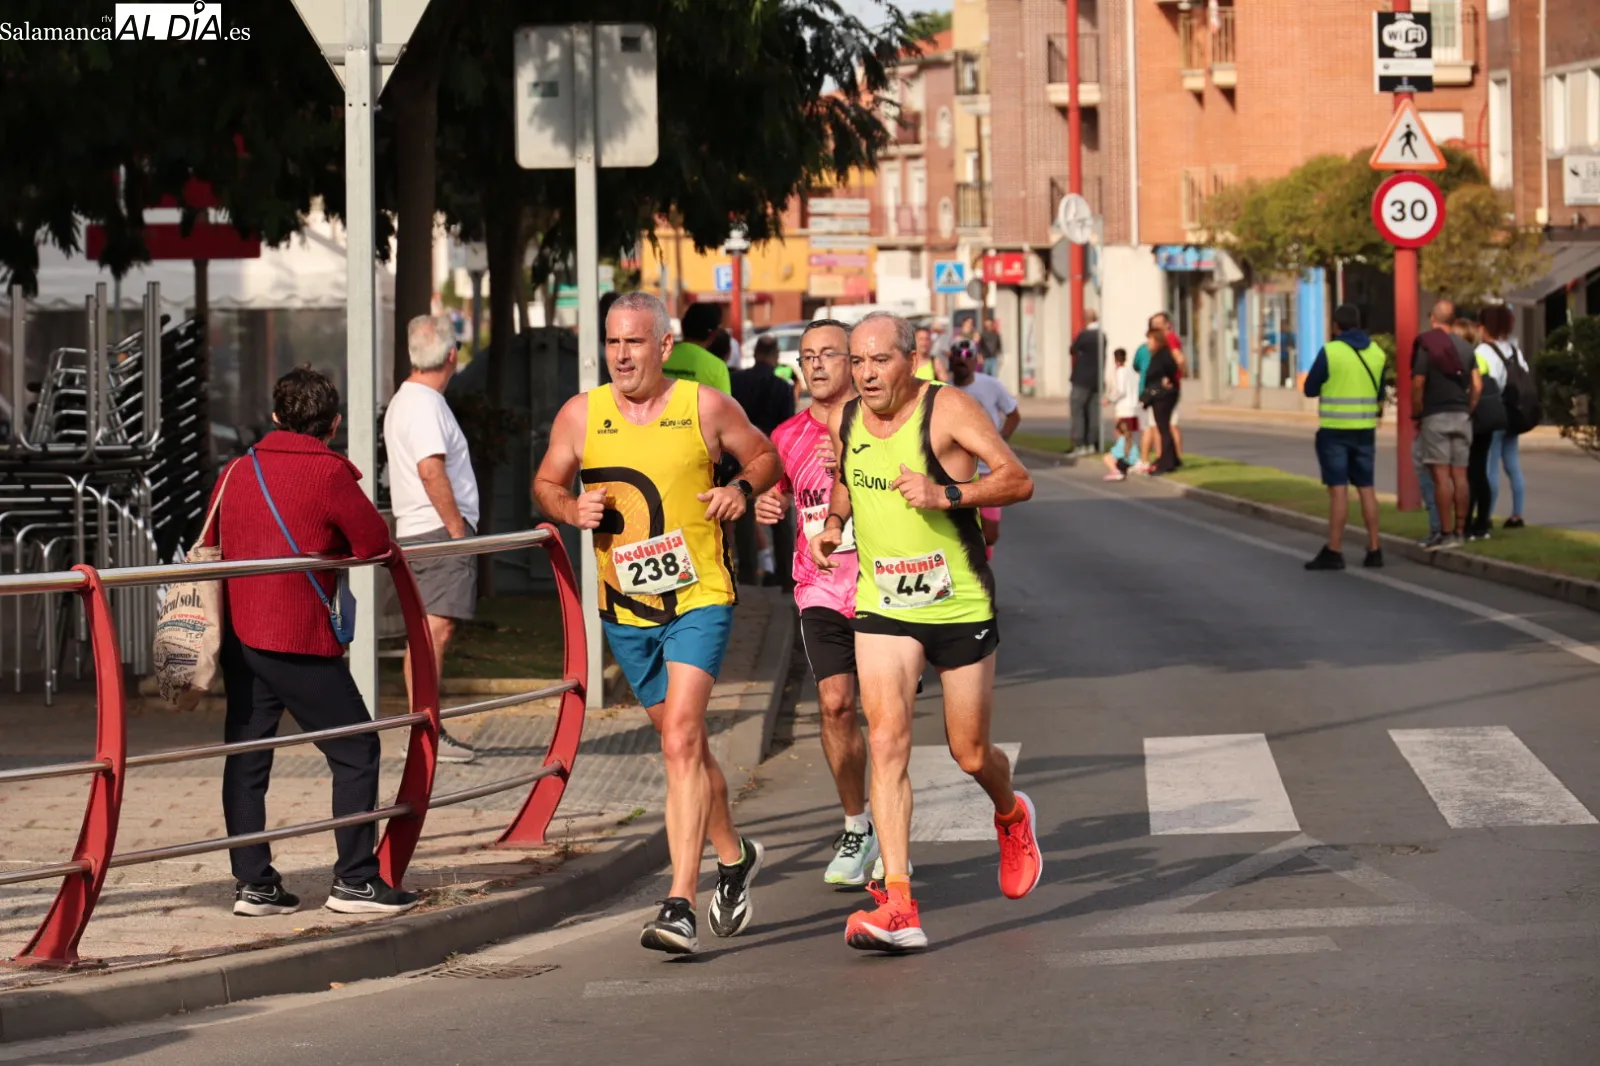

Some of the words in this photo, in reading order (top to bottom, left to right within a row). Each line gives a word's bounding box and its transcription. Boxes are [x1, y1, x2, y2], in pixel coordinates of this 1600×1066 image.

[1390, 200, 1428, 222] 30
[614, 535, 684, 565] bedunia
[628, 552, 680, 586] 238
[875, 555, 945, 575] bedunia
[897, 573, 931, 596] 44
